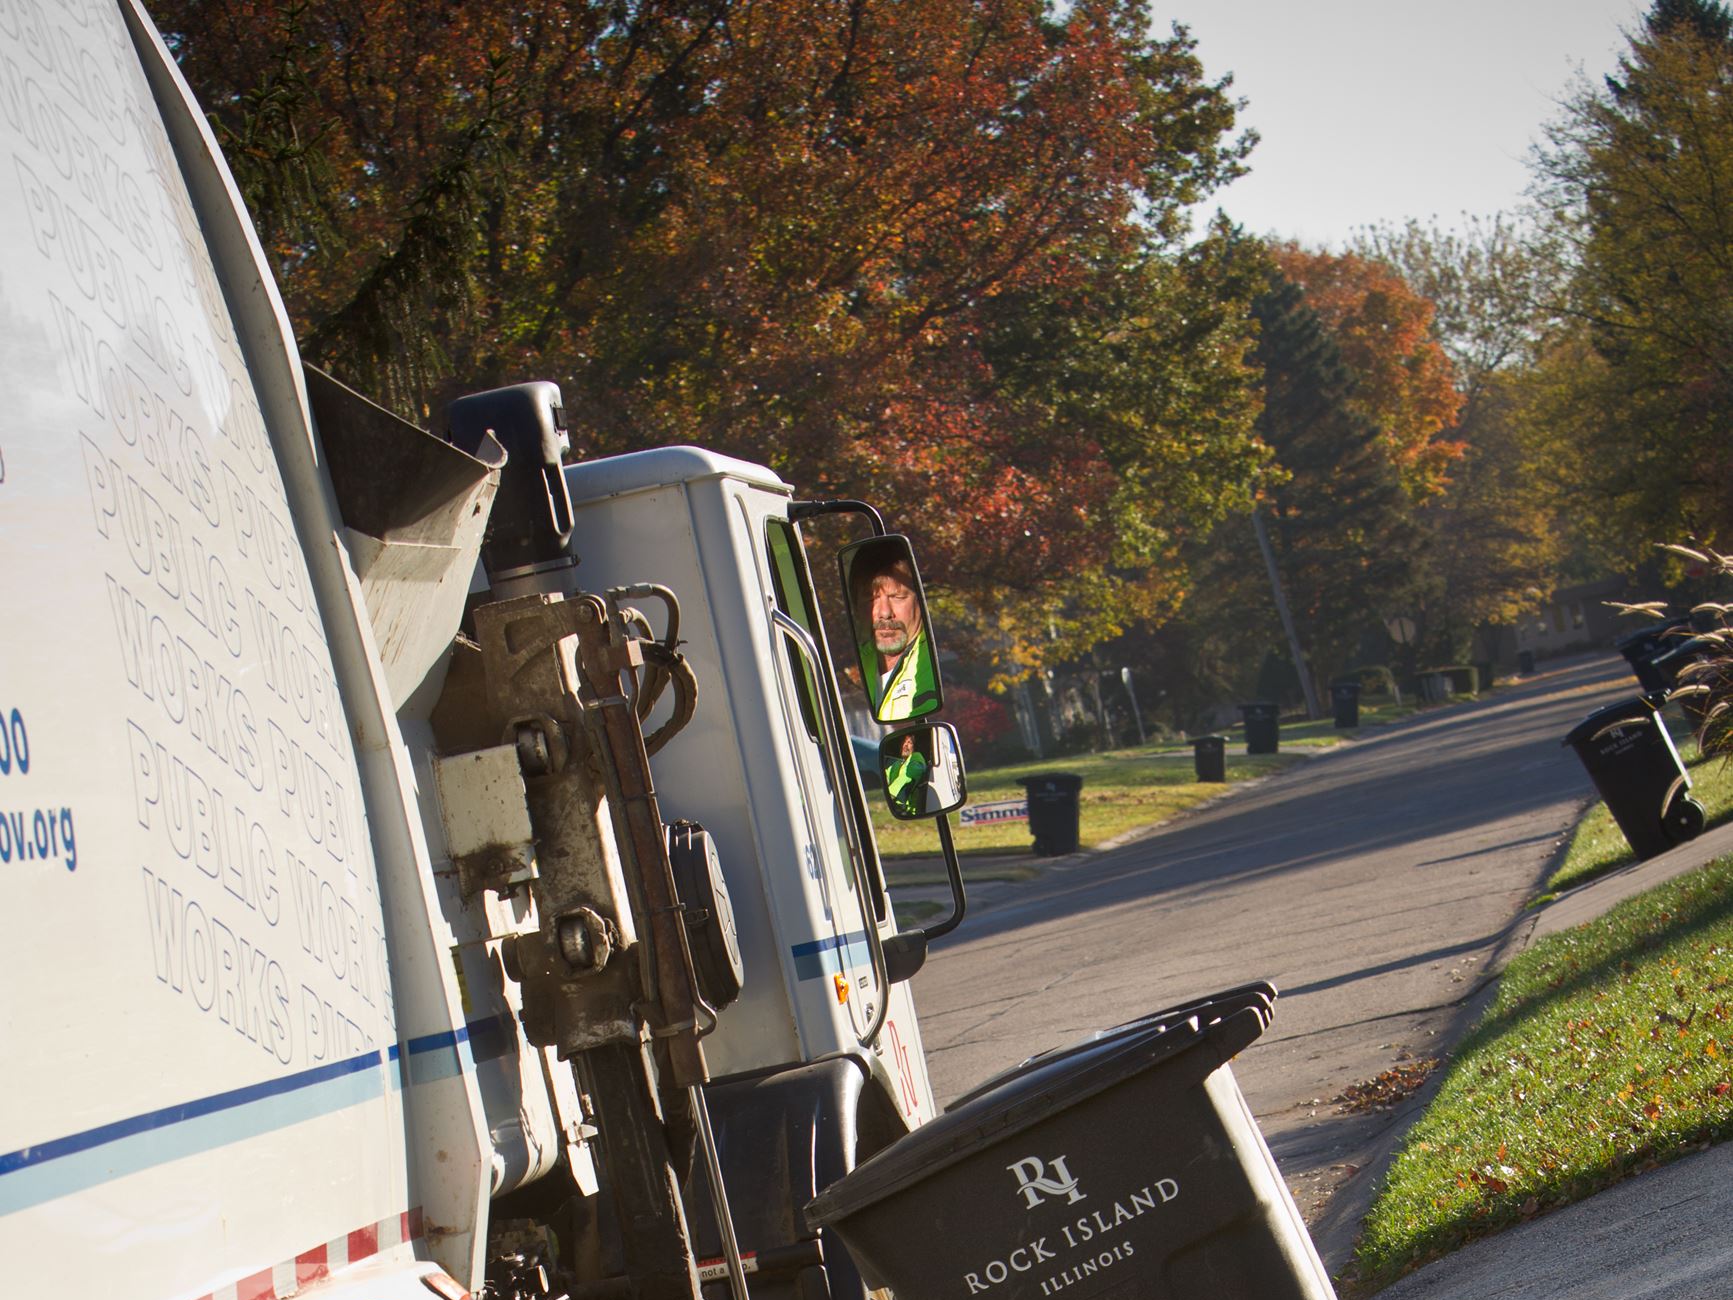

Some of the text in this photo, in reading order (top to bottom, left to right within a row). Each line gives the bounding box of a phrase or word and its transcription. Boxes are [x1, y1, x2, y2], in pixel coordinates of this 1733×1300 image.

[11, 152, 193, 398] PUBLIC
[47, 288, 221, 529] WORKS
[79, 430, 242, 659] PUBLIC
[105, 572, 264, 792] WORKS
[0, 806, 78, 872] ov.org
[126, 717, 281, 928] PUBLIC
[142, 865, 294, 1066] WORKS
[701, 1267, 717, 1278] not
[963, 1178, 1180, 1295] ROCK ISLAND
[1040, 1240, 1135, 1296] ILLINOIS
